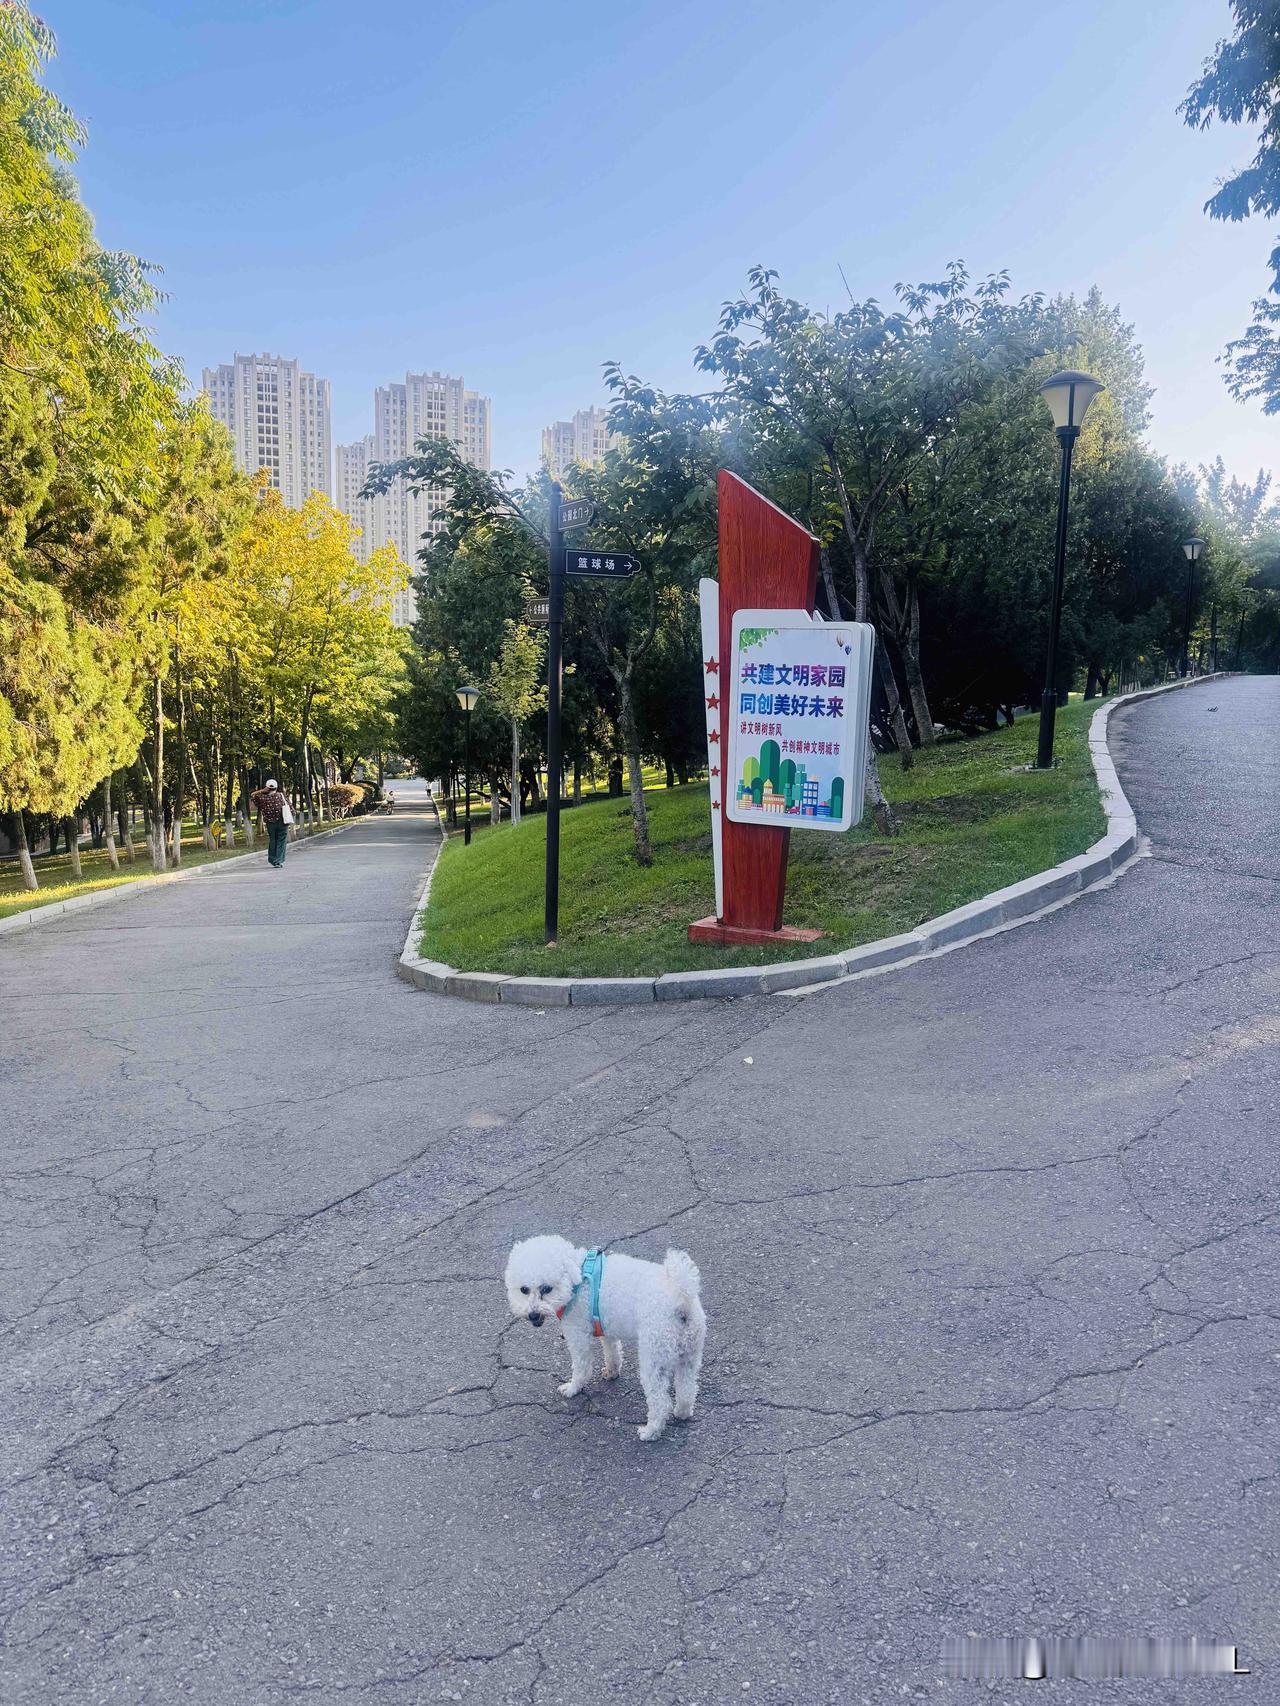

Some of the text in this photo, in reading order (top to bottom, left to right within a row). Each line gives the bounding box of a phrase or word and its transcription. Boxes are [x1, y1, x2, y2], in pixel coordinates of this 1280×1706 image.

[577, 557, 615, 570] 篮球场
[741, 662, 846, 688] 共建文明家园
[740, 693, 844, 718] 同创美好未来
[740, 721, 782, 736] 讲文明树新风
[781, 739, 840, 756] 共创精神文明城市
